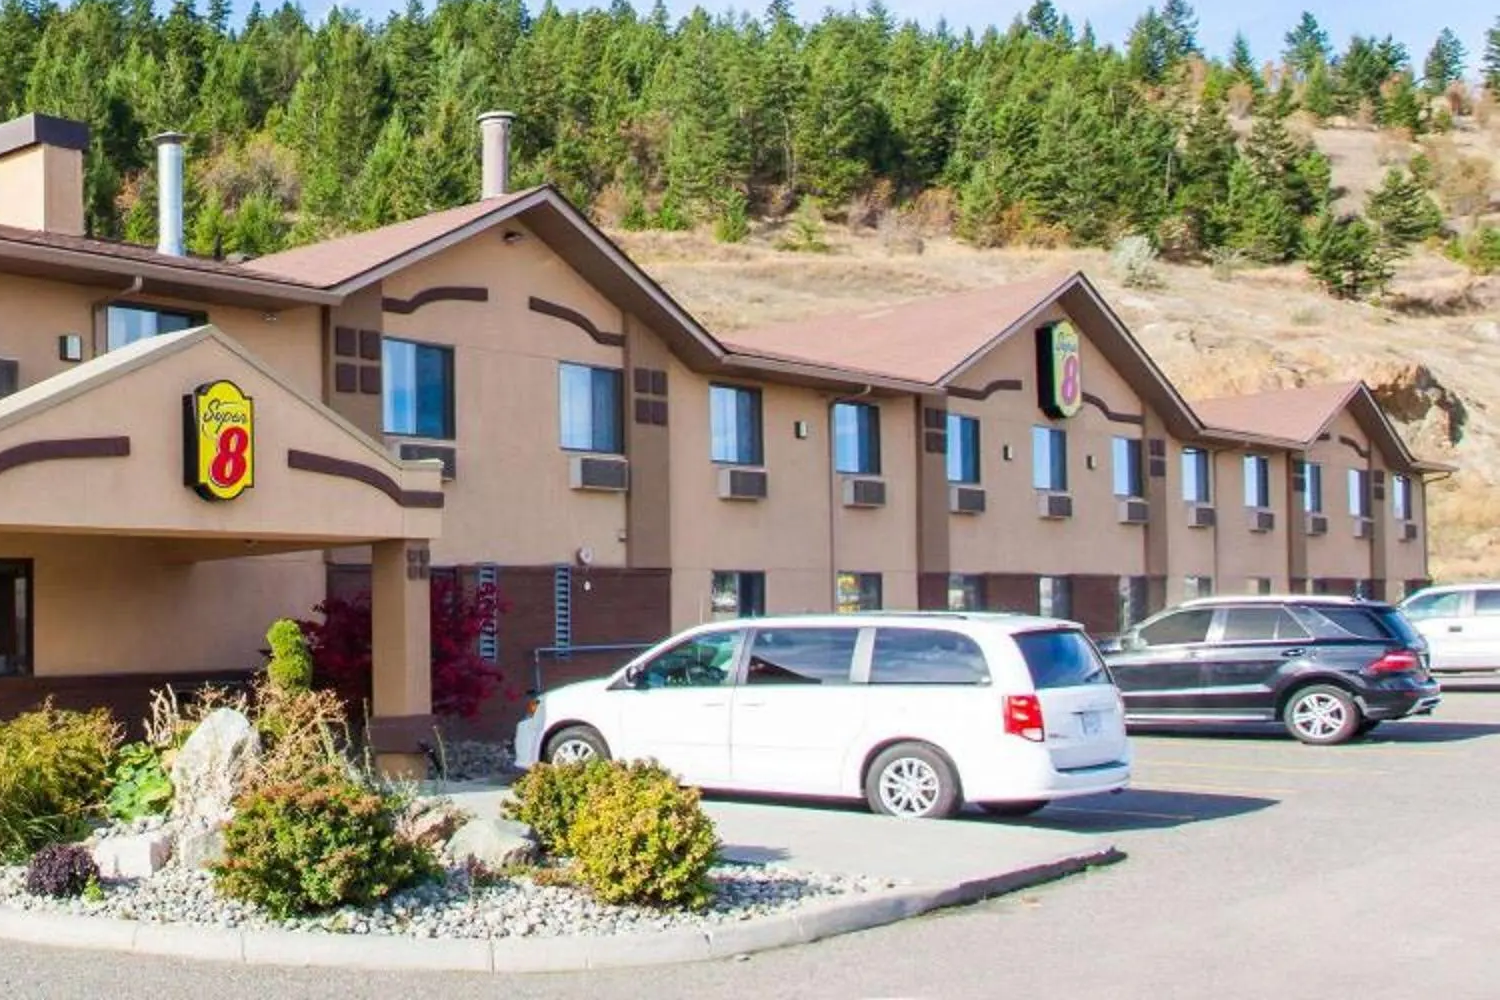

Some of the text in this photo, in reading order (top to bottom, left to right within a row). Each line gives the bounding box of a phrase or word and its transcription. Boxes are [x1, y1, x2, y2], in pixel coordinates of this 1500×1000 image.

[1062, 356, 1078, 405] 8
[202, 398, 247, 434] Super
[209, 426, 248, 487] 8
